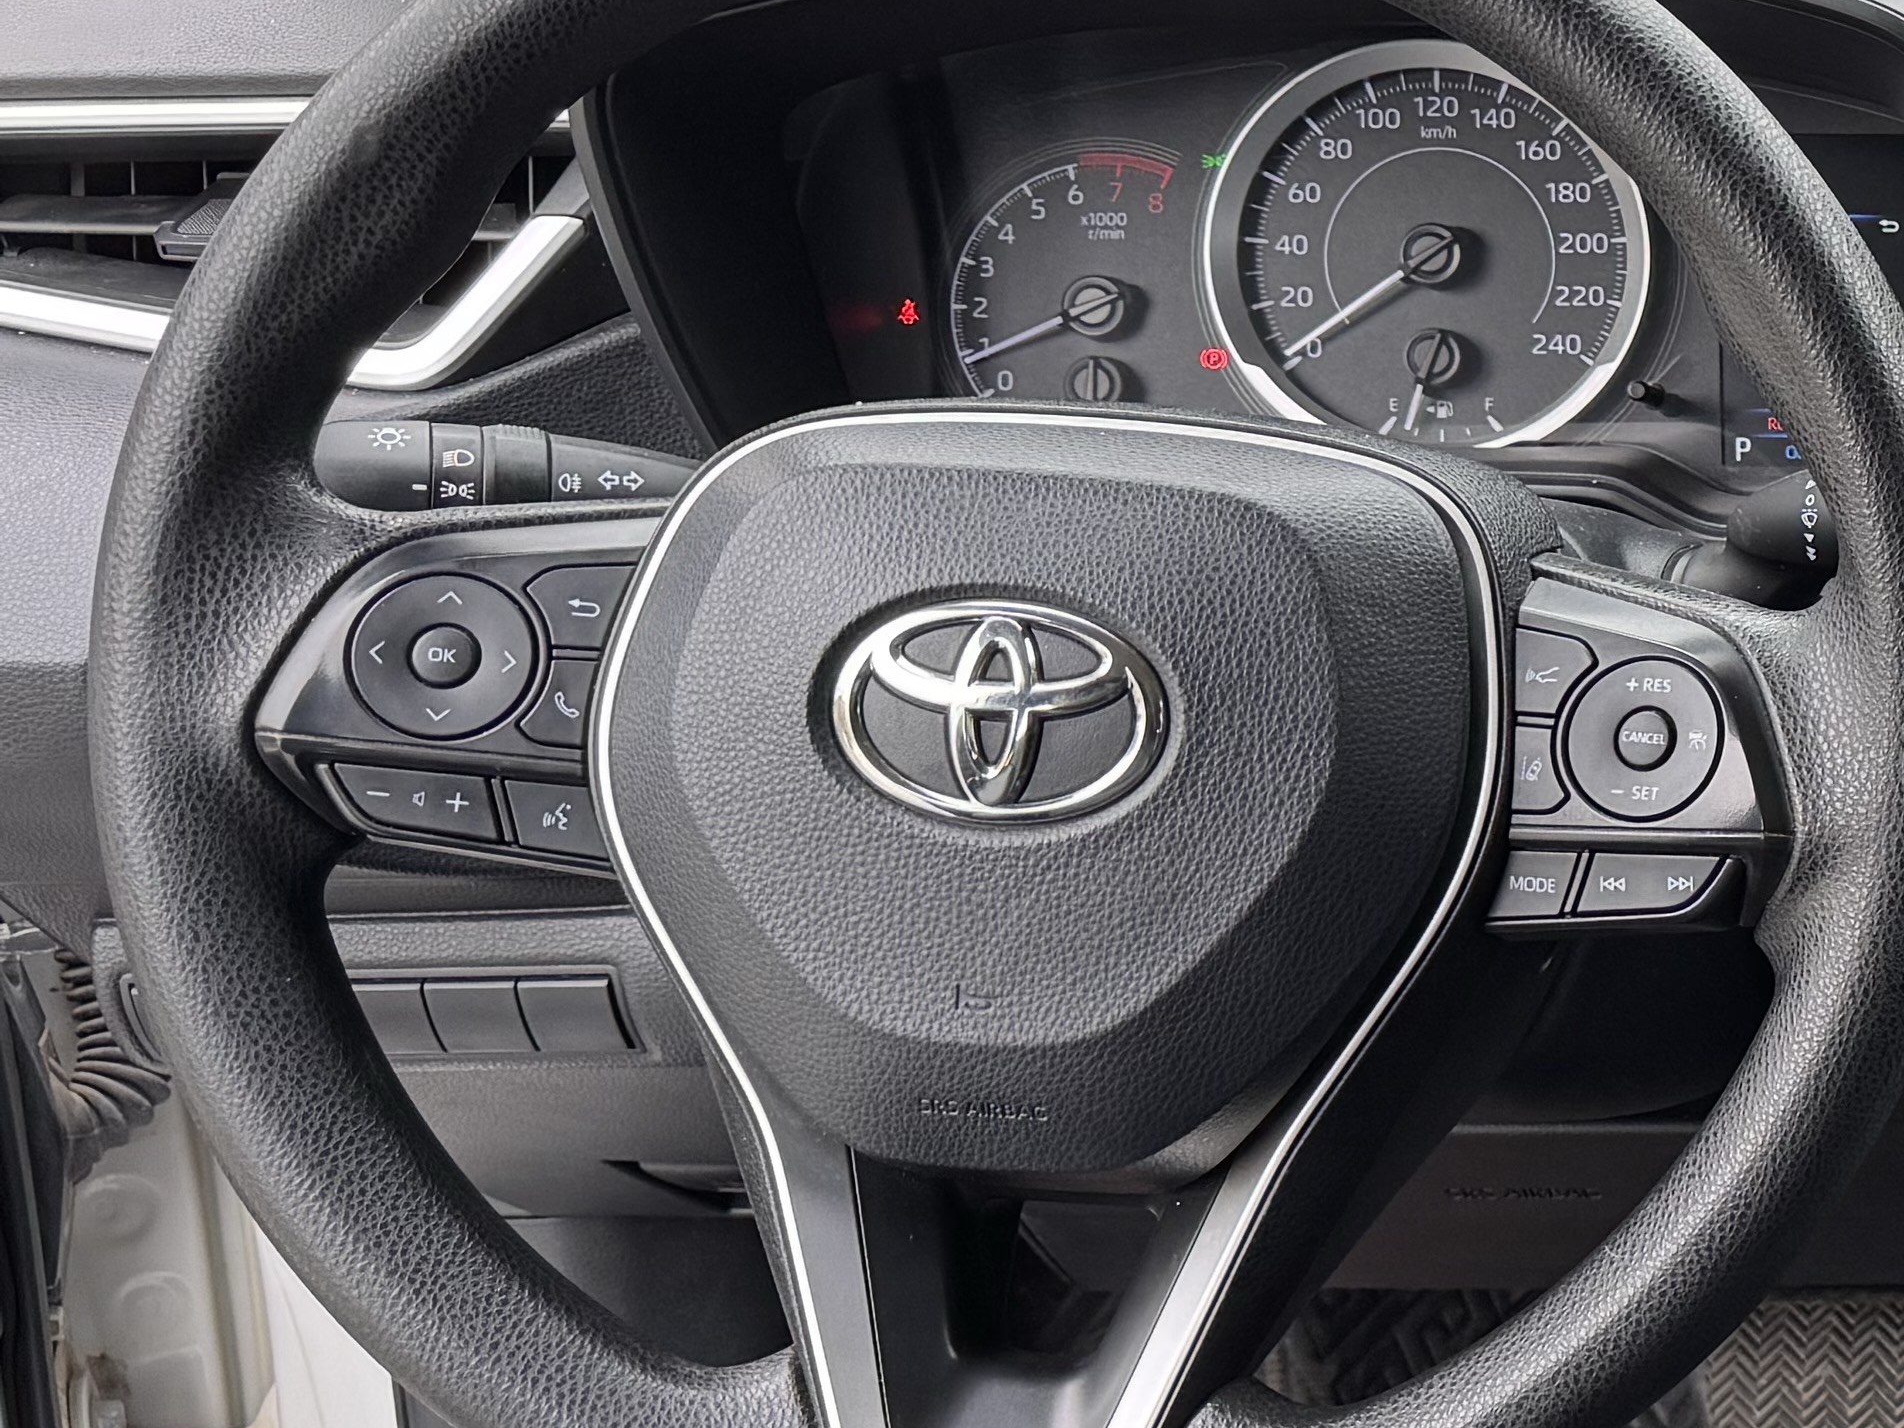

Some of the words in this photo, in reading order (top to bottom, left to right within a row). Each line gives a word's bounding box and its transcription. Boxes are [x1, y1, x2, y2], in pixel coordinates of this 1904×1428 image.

[1414, 96, 1459, 118] 120
[1355, 108, 1401, 129] 100
[1470, 108, 1517, 129] 140
[1420, 125, 1458, 140] km/h
[1319, 138, 1353, 160] 80
[1515, 140, 1562, 161] 160
[1067, 184, 1084, 205] 6
[1109, 182, 1124, 203] 7
[1148, 192, 1164, 214] 8
[1287, 182, 1322, 204] 60
[1545, 182, 1592, 203] 180
[1030, 198, 1046, 220] 5
[1080, 212, 1128, 227] x1000
[997, 223, 1016, 245] 4
[1088, 227, 1125, 241] r/min
[1275, 233, 1309, 255] 40
[1558, 232, 1609, 254] 200
[979, 256, 995, 278] 3
[1279, 286, 1314, 308] 20
[1554, 285, 1605, 307] 220
[972, 297, 989, 319] 2
[1305, 337, 1322, 358] 0
[1531, 334, 1582, 355] 240
[996, 370, 1014, 392] 0
[1388, 398, 1398, 412] E
[1485, 397, 1494, 411] F
[1735, 436, 1752, 462] P
[428, 646, 457, 664] OK
[1642, 677, 1672, 693] RES
[1621, 730, 1667, 745] CANCEL
[1631, 785, 1660, 801] SET
[1509, 875, 1557, 893] MODE
[919, 1098, 959, 1116] SRS
[965, 1100, 1049, 1121] AIRBAG
